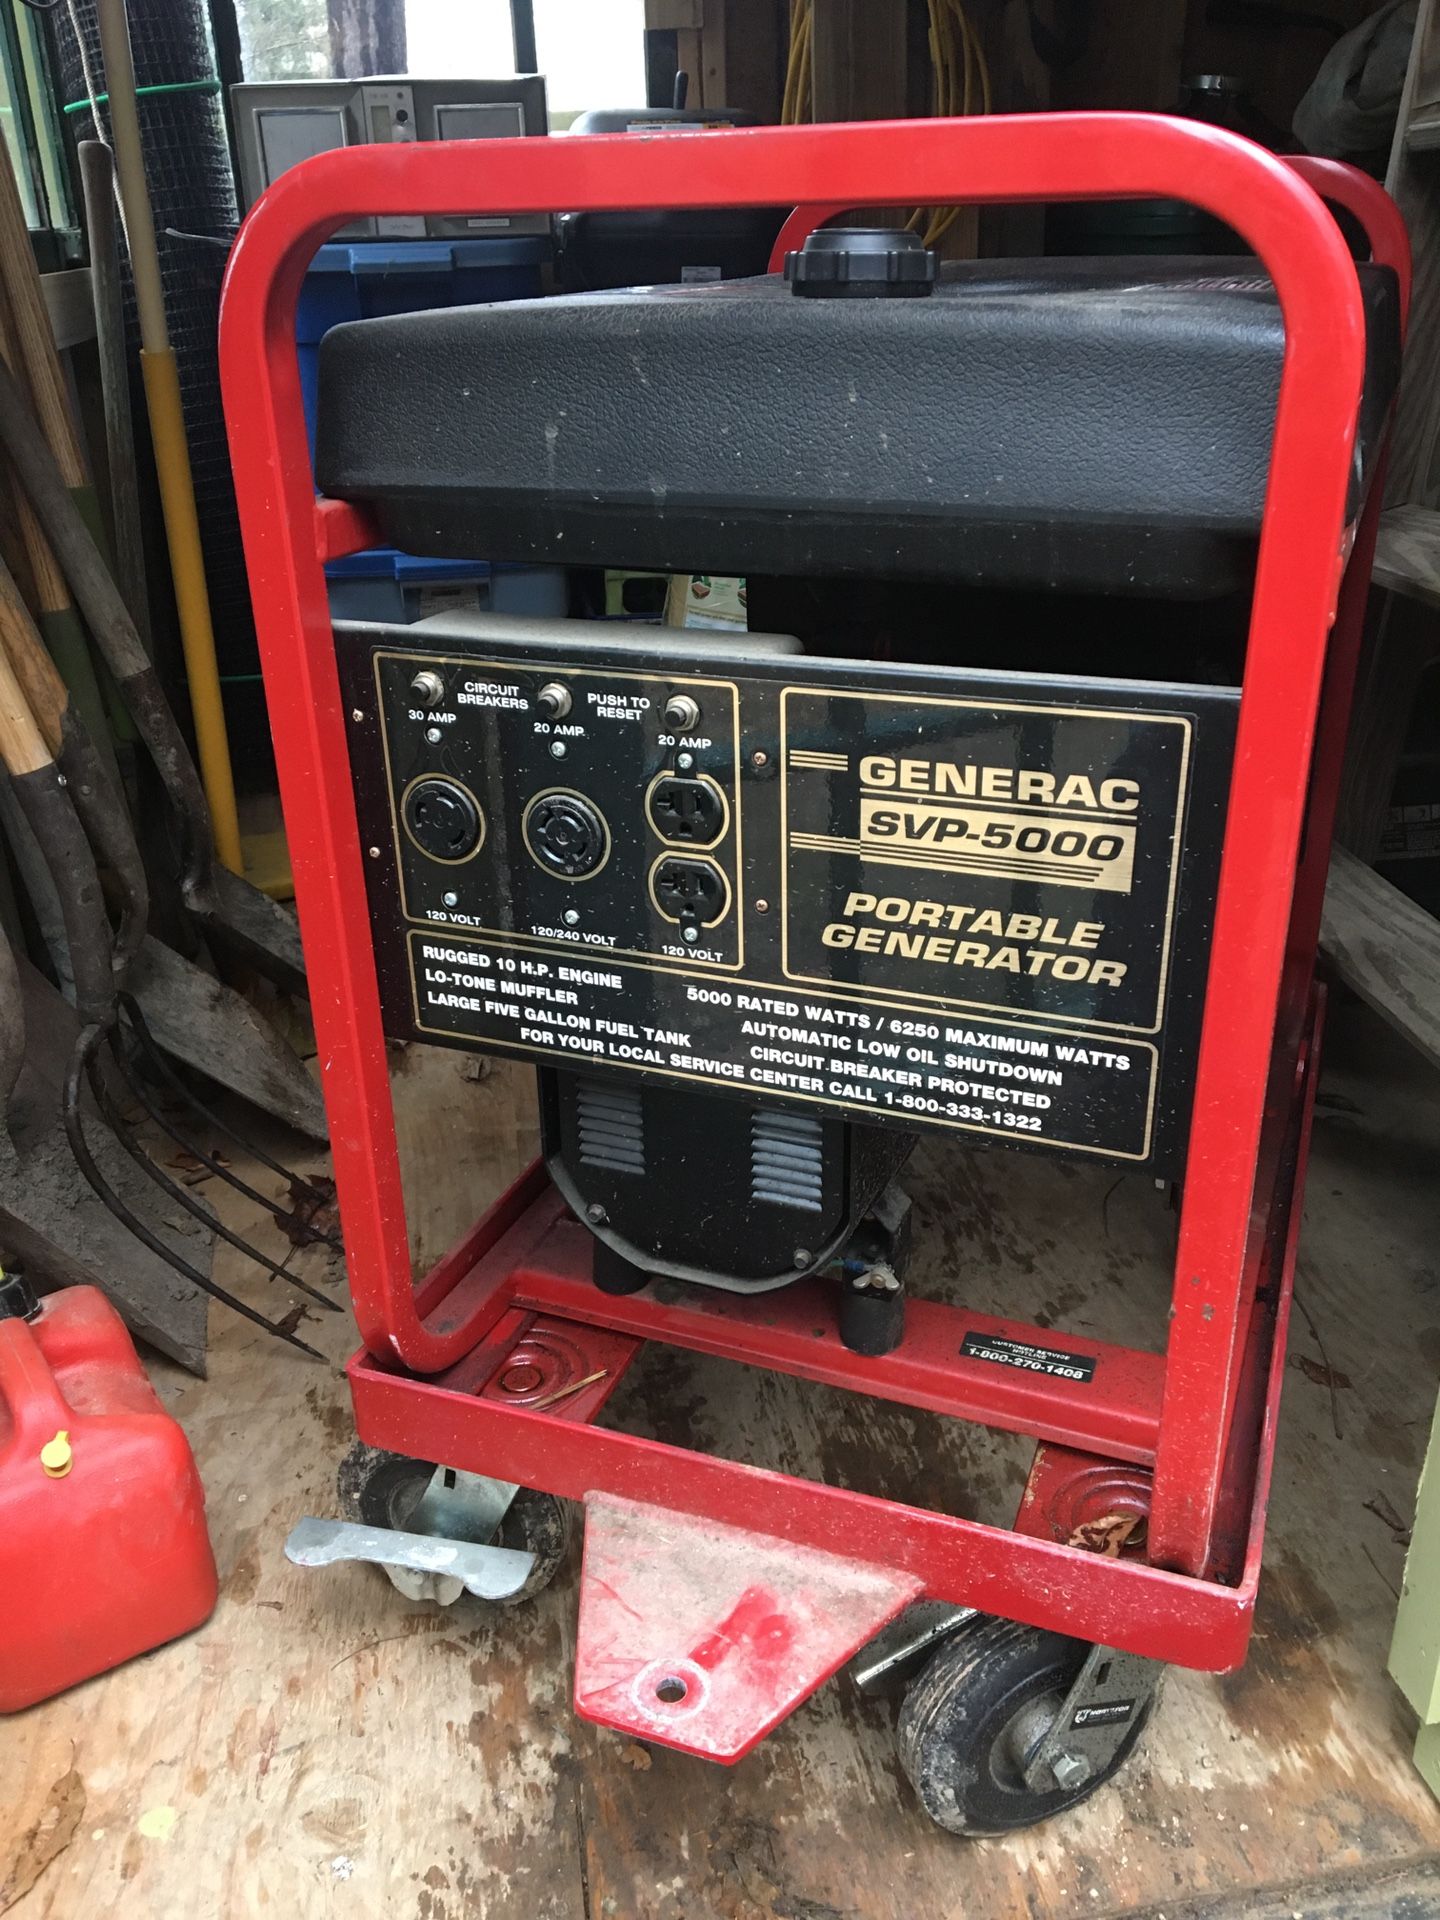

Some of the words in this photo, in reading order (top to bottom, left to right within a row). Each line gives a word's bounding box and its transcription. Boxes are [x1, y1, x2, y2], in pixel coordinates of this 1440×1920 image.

[457, 693, 529, 710] BREAKERS
[464, 681, 520, 697] CIRCUIT
[587, 693, 627, 708] PUSH
[630, 697, 651, 709] TO
[408, 709, 425, 721] 30
[427, 710, 457, 724] AMP
[534, 722, 550, 734] 20
[553, 724, 585, 737] AMP
[597, 706, 642, 721] RESET
[658, 734, 675, 746] 20
[679, 736, 712, 750] AMP
[859, 755, 1140, 811] GENERAC
[867, 810, 1125, 861] SVP-5000
[426, 909, 447, 922] 120
[449, 912, 481, 926] VOLT
[843, 892, 1106, 949] PORTABLE
[531, 926, 580, 941] 120/240
[583, 933, 616, 947] VOLT
[423, 945, 491, 968] RUGGED
[496, 958, 516, 972] 10
[520, 961, 554, 978] H.P.
[558, 967, 623, 989] ENGINE
[661, 945, 685, 957] 120
[688, 948, 723, 962] VOLT
[821, 923, 1128, 987] GENERATOR
[425, 968, 496, 992] LO-TONE
[501, 980, 578, 1005] MUFFLER
[428, 991, 481, 1012] LARGE
[485, 1001, 521, 1019] FIVE
[524, 1007, 591, 1031] GALLON
[596, 1019, 639, 1039] FUEL
[644, 1027, 691, 1048] TANK
[687, 987, 732, 1006] 5000
[737, 995, 799, 1017] RATED
[805, 1005, 871, 1029] WATTS
[876, 1017, 885, 1031] /
[890, 1020, 939, 1039] 6250
[945, 1027, 1049, 1058] MAXIMUM
[1055, 1045, 1131, 1071] WATTS
[741, 1020, 851, 1050] AUTOMATIC
[857, 1038, 901, 1059] LOW
[906, 1047, 939, 1066] OIL
[944, 1054, 1063, 1086] SHUTDOWN
[520, 1027, 554, 1045] FOR
[558, 1033, 605, 1053] YOUR
[609, 1042, 665, 1065] LOCAL
[670, 1053, 745, 1079] SERVICE
[750, 1067, 824, 1092] CENTER
[829, 1081, 877, 1102] CALL
[884, 1091, 1042, 1132] 1-800-333-1322
[750, 1046, 825, 1070] CIRCUIT
[830, 1059, 922, 1088] BREAKER
[928, 1075, 1051, 1109] PROTECTED
[968, 1347, 1084, 1379] 1-800-270-1408
[991, 1340, 1035, 1353] CUSTOMER
[1036, 1348, 1071, 1360] SERVICE
